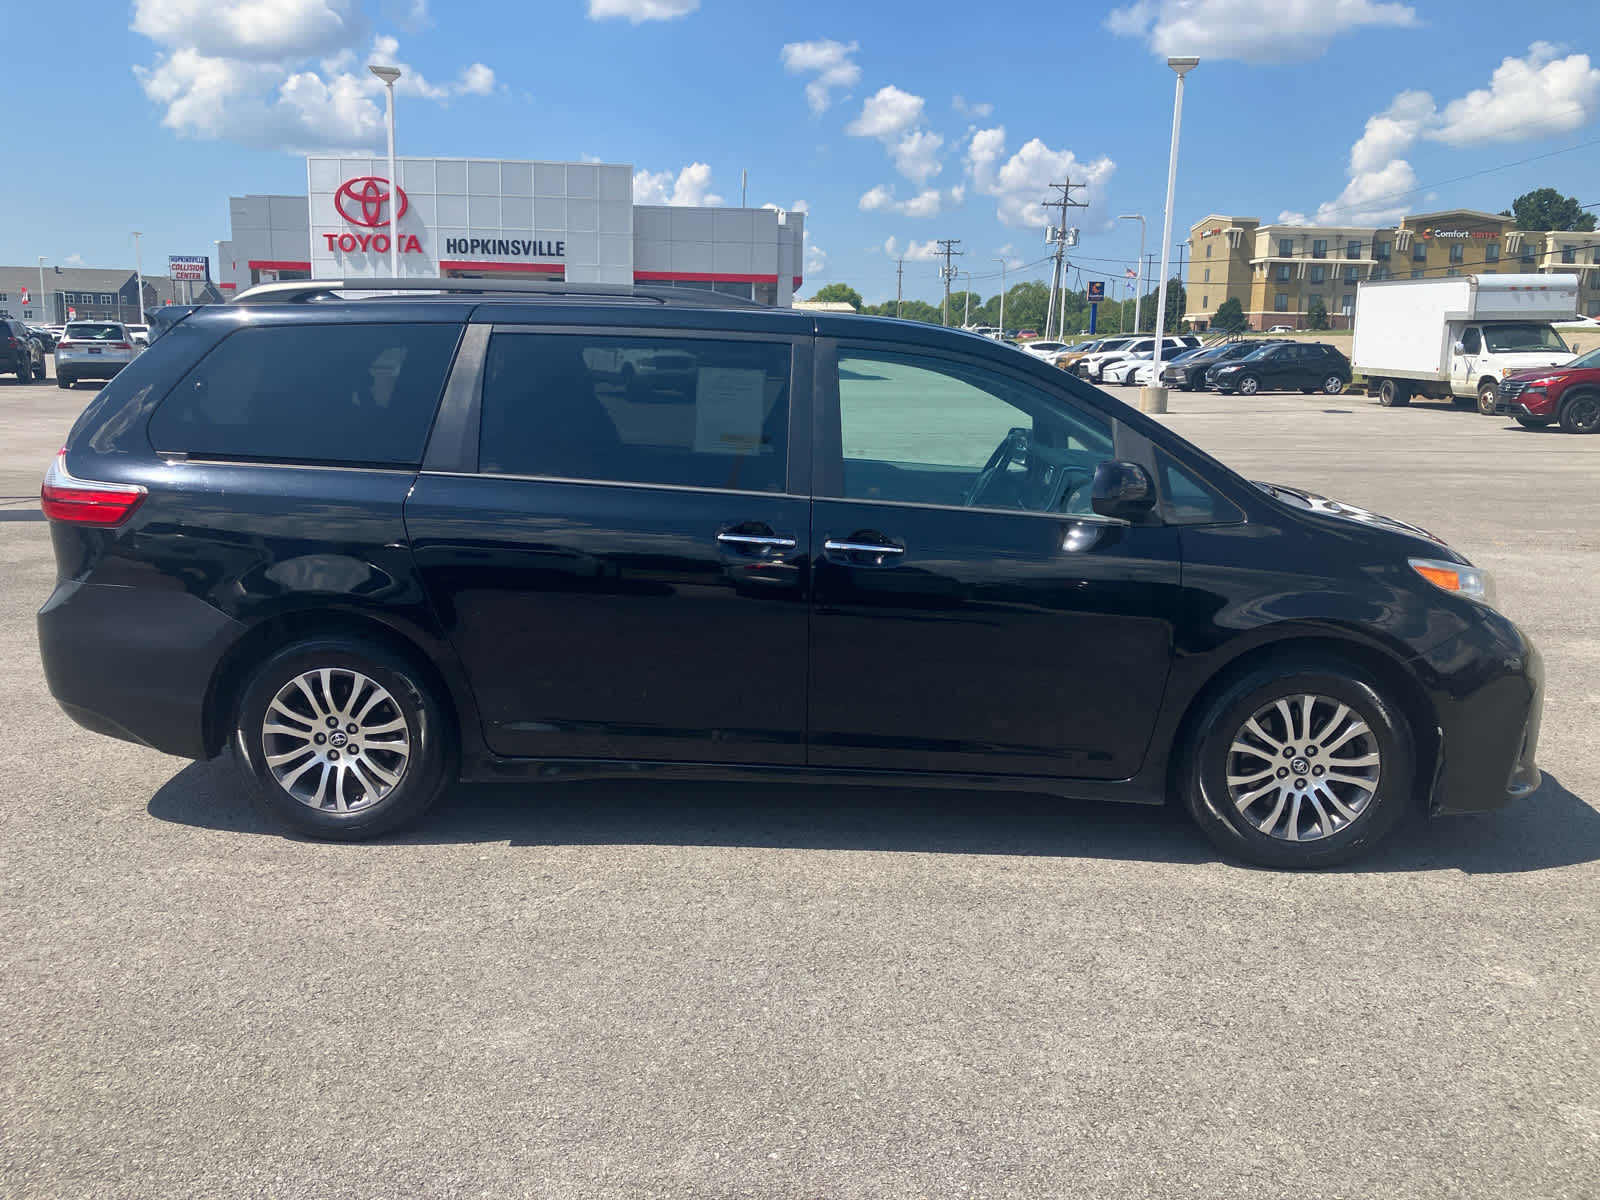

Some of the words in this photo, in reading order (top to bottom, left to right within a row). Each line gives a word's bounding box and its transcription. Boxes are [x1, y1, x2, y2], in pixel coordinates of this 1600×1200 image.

[1434, 229, 1469, 239] Comfort
[322, 232, 423, 253] TOYOTA
[446, 238, 566, 257] HOPKINSVILLE
[171, 263, 205, 272] COLLISION
[176, 271, 201, 280] CENTER
